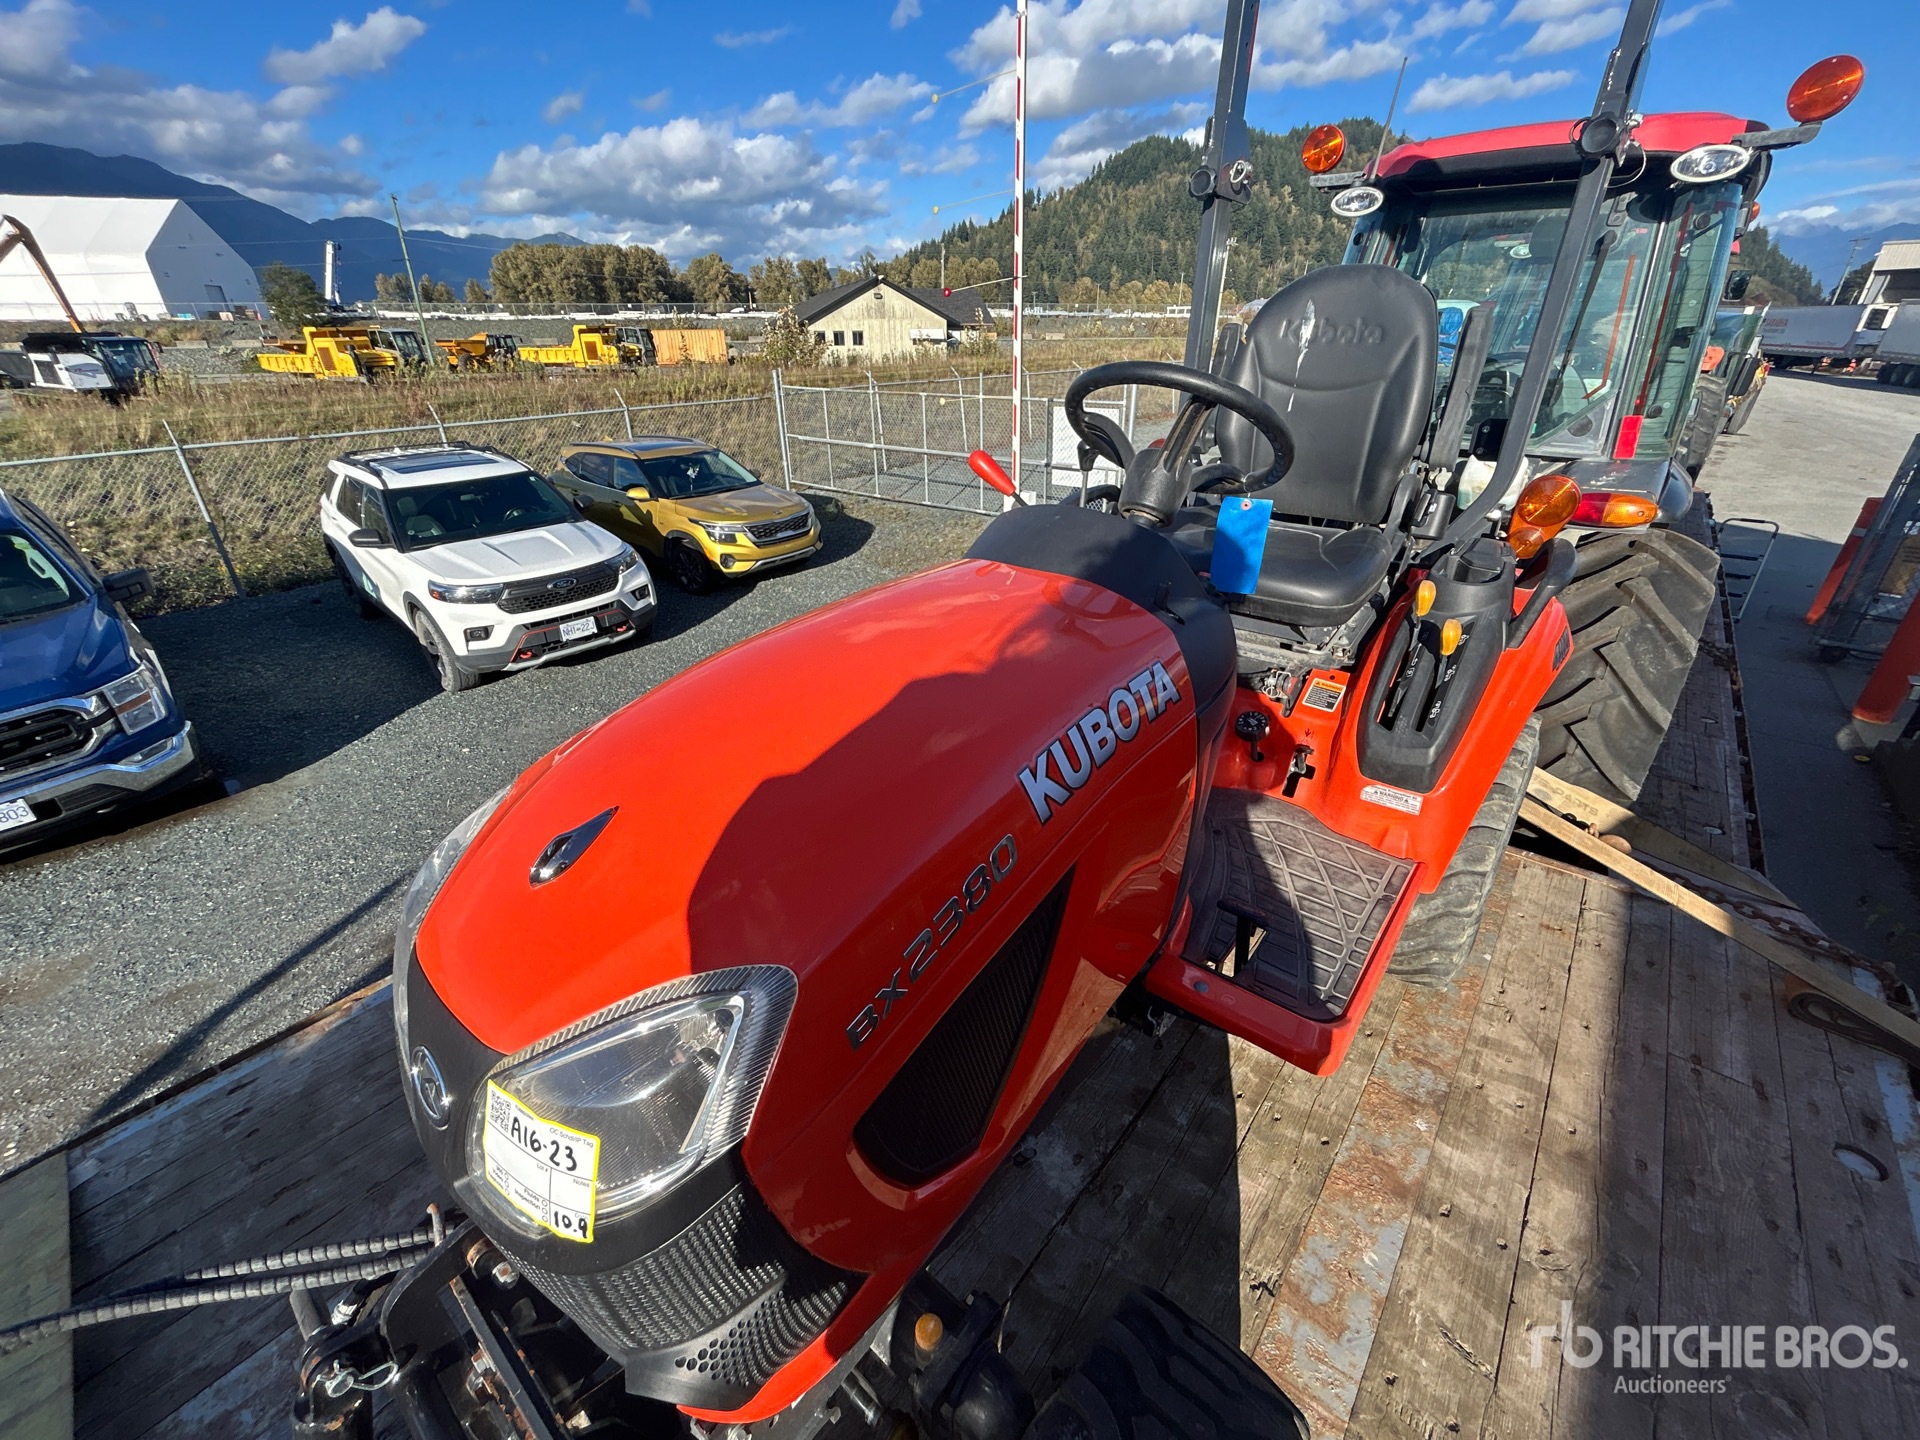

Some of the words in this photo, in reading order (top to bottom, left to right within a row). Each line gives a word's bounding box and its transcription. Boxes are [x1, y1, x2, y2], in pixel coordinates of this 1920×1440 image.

[1017, 660, 1182, 824] KUBOTA
[1379, 790, 1404, 802] WARNING
[0, 806, 29, 823] 803
[845, 833, 1018, 1050] BX2380
[511, 1116, 578, 1171] A16-23
[582, 1139, 594, 1149] Tag
[536, 1162, 544, 1171] Lot
[572, 1178, 590, 1188] Notes
